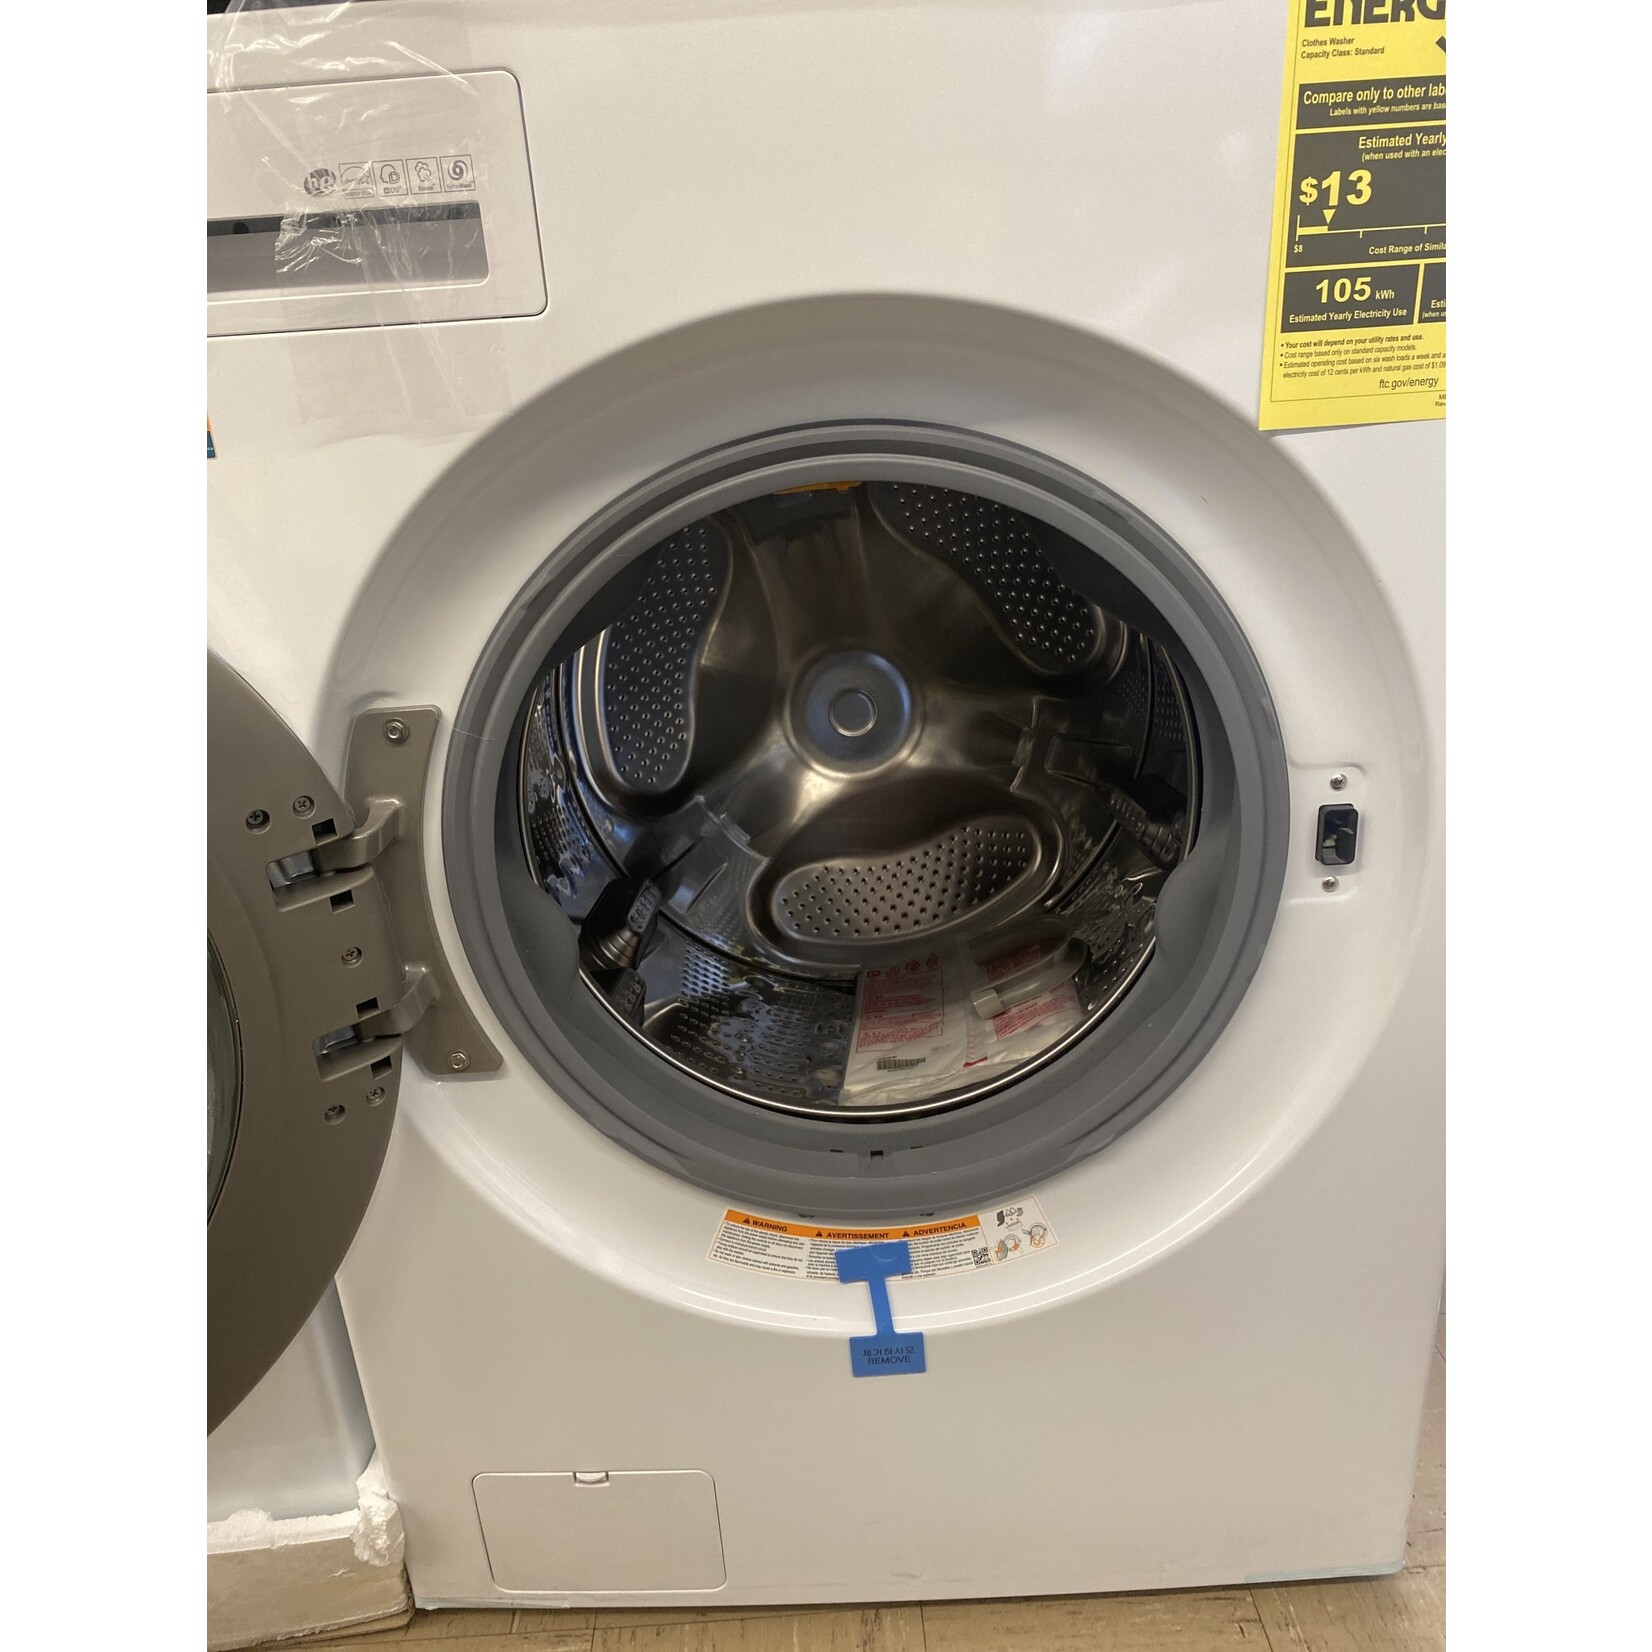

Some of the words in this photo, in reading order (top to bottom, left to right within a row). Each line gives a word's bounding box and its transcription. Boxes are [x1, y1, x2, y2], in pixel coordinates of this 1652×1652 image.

[1302, 38, 1328, 48] Clothes
[1329, 36, 1355, 46] Washer
[1300, 50, 1330, 60] Capacity
[1331, 48, 1353, 58] Class:
[1354, 46, 1385, 56] Standard
[1303, 90, 1353, 106] Compare
[1356, 86, 1380, 103] only
[1383, 86, 1394, 100] to
[1397, 85, 1426, 99] other
[1329, 107, 1351, 117] Labels
[1353, 106, 1367, 115] with
[1368, 104, 1390, 115] yellow
[1391, 103, 1420, 113] numbers
[1421, 103, 1432, 111] are
[1358, 134, 1412, 149] Estimated
[1361, 151, 1384, 163] (when
[1385, 150, 1403, 160] used
[1404, 149, 1420, 158] with
[1421, 149, 1431, 157] an
[1298, 168, 1373, 207] $13
[1293, 244, 1304, 254] $8
[1368, 245, 1387, 256] Cost
[1388, 244, 1413, 255] Range
[1414, 243, 1423, 253] of
[1315, 276, 1372, 304] 105
[1375, 289, 1395, 300] kWh
[1289, 313, 1327, 324] Estimated
[1328, 311, 1353, 323] Yearly
[1354, 308, 1392, 320] Electricity
[1392, 307, 1407, 317] Use
[1285, 341, 1299, 349] Your
[1299, 340, 1312, 348] cost
[1312, 339, 1323, 347] will
[1323, 338, 1345, 347] depend
[1354, 338, 1368, 346] your
[1368, 335, 1384, 345] utility
[1284, 351, 1298, 359] Cost
[1314, 349, 1331, 357] based
[1331, 348, 1343, 357] only
[1283, 360, 1310, 369] Estimated
[1310, 359, 1335, 368] operating
[1327, 368, 1334, 376] 12
[1378, 376, 1440, 390] ftc.gov/energy
[752, 1219, 788, 1232] WARNING
[913, 1222, 967, 1236] ADVERTENCIA
[867, 1355, 912, 1366] REMOVE
